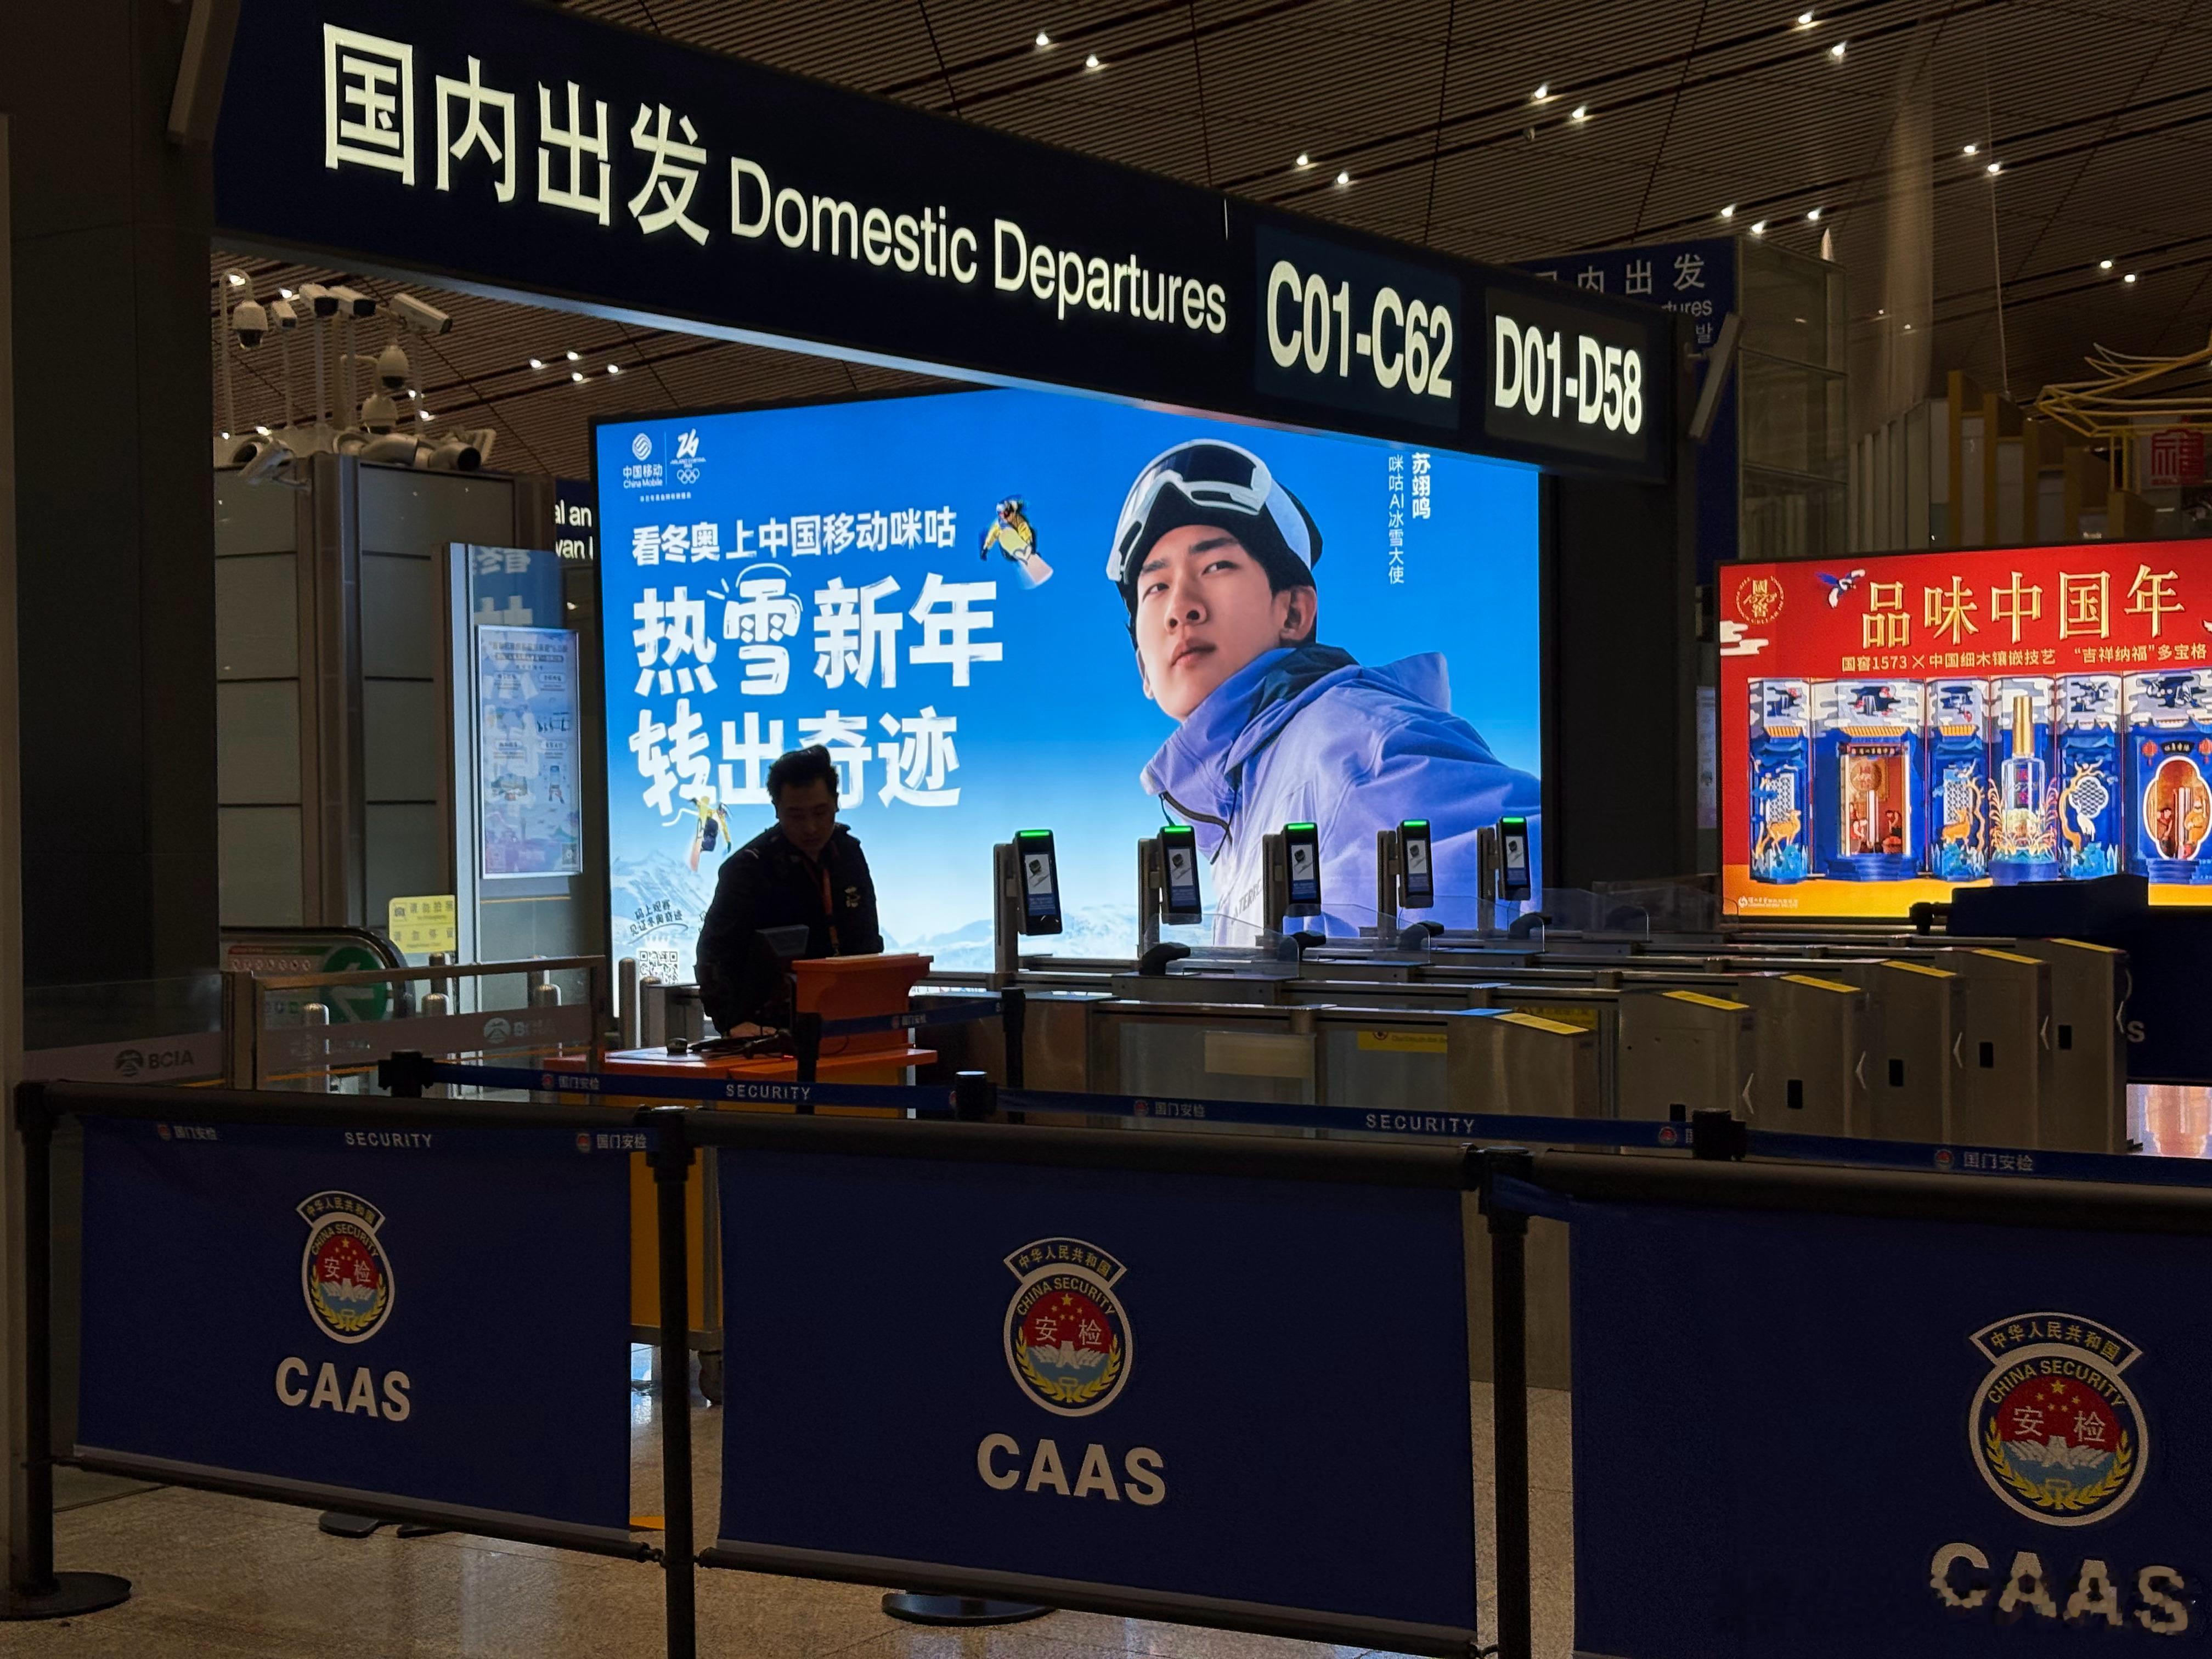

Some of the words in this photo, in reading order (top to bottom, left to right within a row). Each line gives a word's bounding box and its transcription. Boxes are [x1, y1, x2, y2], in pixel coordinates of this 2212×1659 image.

[324, 22, 710, 246] 国内出发
[731, 156, 978, 284] Domestic
[994, 218, 1227, 334] Departures
[1536, 254, 1705, 295] 内出发
[1267, 260, 1453, 399] C01-C62
[1495, 315, 1642, 435] D01-D58
[623, 464, 663, 479] 中国移动
[623, 479, 642, 488] China
[642, 477, 663, 487] Mobile
[1412, 452, 1431, 519] 苏翊鸣
[633, 506, 957, 566] 看冬奥上中国移动咪咕
[1388, 454, 1404, 584] 咪咕AI冰雪大使
[1861, 563, 2186, 649] 品味中国年
[633, 573, 1003, 697] 热雪新年
[629, 698, 961, 817] 转出奇迹
[148, 1049, 195, 1070] BCIA
[725, 1084, 811, 1101] SECURITY
[345, 1131, 433, 1148] SECURITY
[596, 1133, 647, 1150] 国门安检
[1365, 1113, 1476, 1135] SECURITY
[306, 1197, 376, 1225] 中华人民共和国
[311, 1226, 335, 1256] CHINA
[336, 1224, 379, 1257] SECURITY
[1018, 1244, 1111, 1276] 中华人民共和国
[324, 1256, 372, 1283] 安检
[1016, 1281, 1054, 1316] CHINA
[1053, 1277, 1115, 1316] SECURITY
[1035, 1316, 1102, 1346] 安检
[1990, 1321, 2121, 1361] 中华人民共和国
[275, 1357, 411, 1422] CAAS
[1988, 1365, 2036, 1404] CHINA
[2040, 1359, 2126, 1407] SECURITY
[2012, 1406, 2106, 1443] 安检
[977, 1432, 1166, 1506] CAAS
[1930, 1542, 2188, 1634] CAAS
